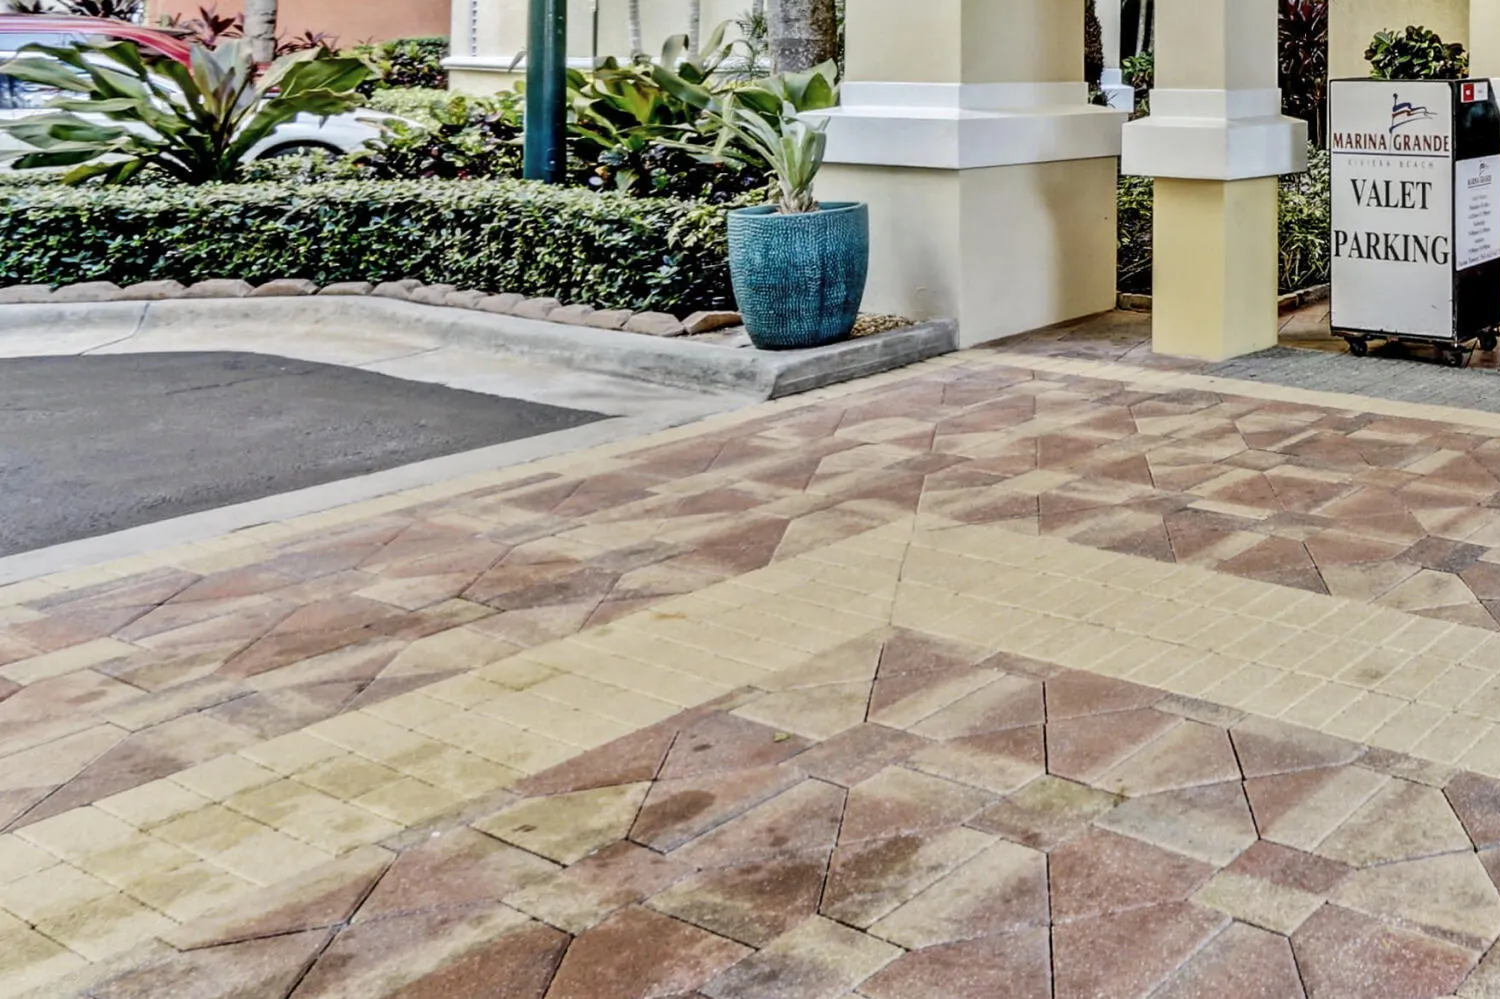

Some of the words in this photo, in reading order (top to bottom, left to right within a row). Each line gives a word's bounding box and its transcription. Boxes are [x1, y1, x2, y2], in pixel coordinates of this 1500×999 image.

[1333, 133, 1387, 149] MARINA
[1393, 134, 1449, 152] GRANDE
[1350, 178, 1432, 210] VALET
[1333, 229, 1450, 266] PARKING
